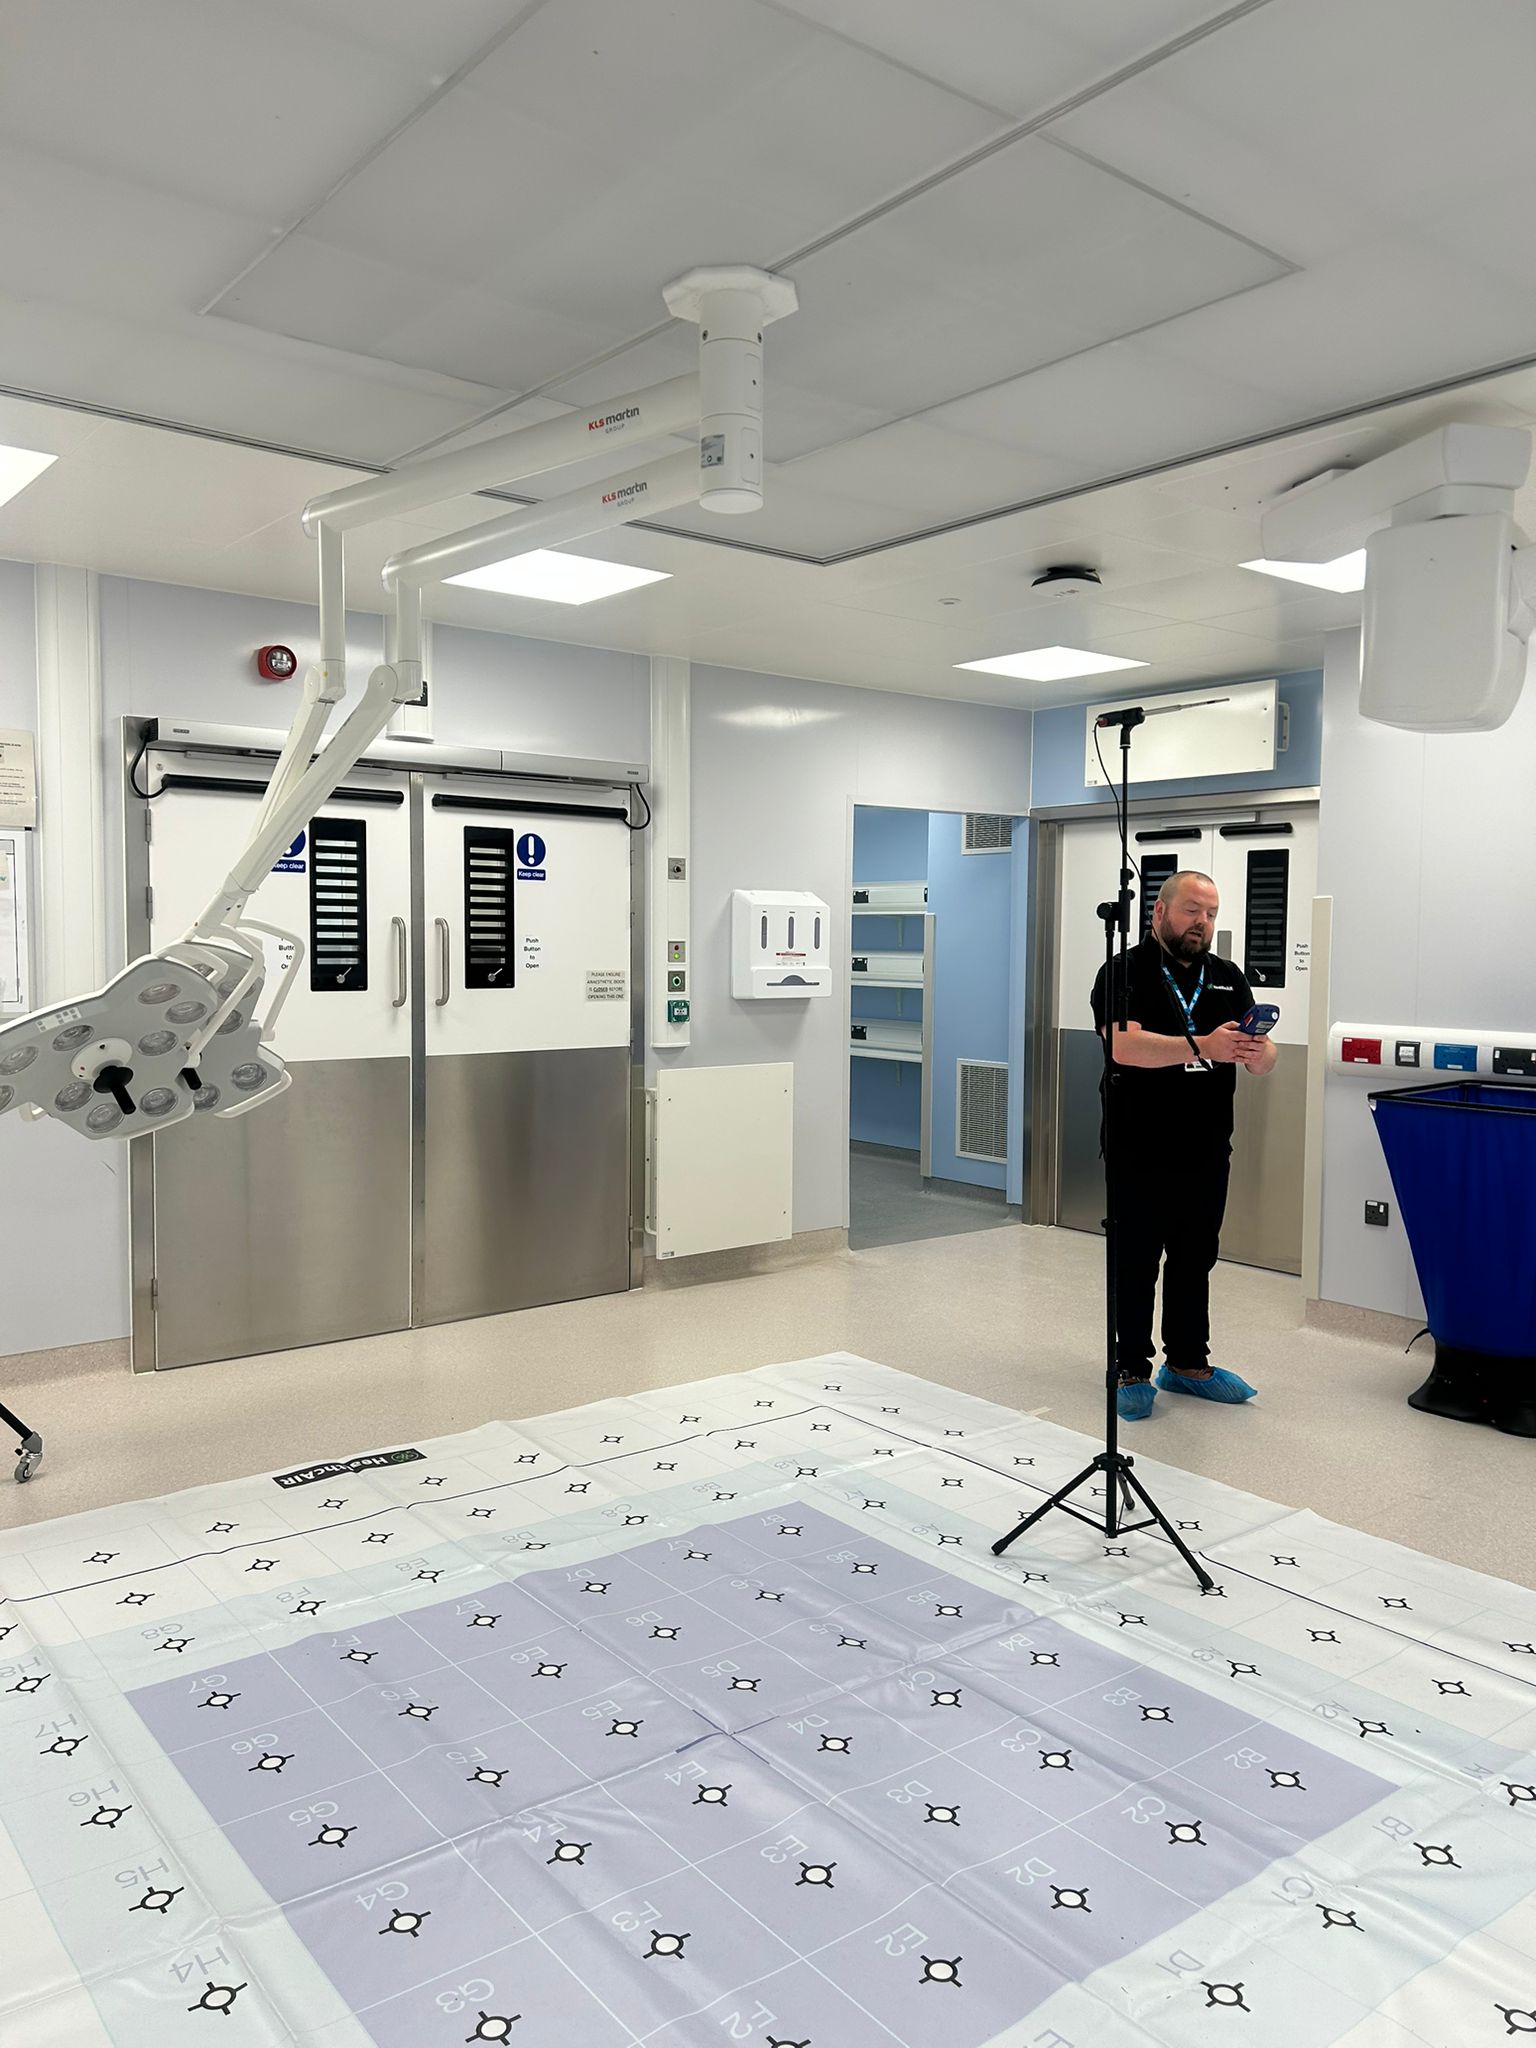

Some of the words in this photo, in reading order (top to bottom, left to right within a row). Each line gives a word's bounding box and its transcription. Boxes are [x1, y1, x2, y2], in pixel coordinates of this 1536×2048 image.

[605, 407, 640, 425] martin
[617, 482, 648, 499] martin
[760, 1514, 787, 1527] B7
[502, 1531, 536, 1544] D8
[395, 1557, 429, 1572] E8
[826, 1550, 859, 1564] B6
[566, 1568, 596, 1583] D7
[276, 1586, 312, 1603] F8
[907, 1589, 941, 1606] B5
[455, 1599, 486, 1616] E7
[626, 1610, 664, 1627] D6
[809, 1622, 844, 1635] C5
[141, 1623, 183, 1640] G8
[331, 1634, 362, 1648] F7
[998, 1632, 1034, 1651] B4
[510, 1645, 550, 1664] E6
[701, 1660, 741, 1678] D5
[189, 1674, 228, 1694] G7
[898, 1670, 935, 1691] C4
[381, 1687, 420, 1701] F6
[1103, 1686, 1142, 1706] B3
[581, 1700, 623, 1721] E5
[35, 1713, 78, 1739] H7
[787, 1713, 829, 1735] D4
[231, 1733, 279, 1754] G6
[1000, 1728, 1042, 1752] C3
[446, 1747, 488, 1765] F5
[1224, 1747, 1267, 1770] B2
[664, 1760, 708, 1786] E4
[68, 1779, 120, 1807] H6
[886, 1780, 933, 1804] D3
[288, 1800, 339, 1827] G5
[1120, 1796, 1166, 1824] C2
[1372, 1816, 1415, 1841] B1
[760, 1834, 809, 1864] E3
[114, 1857, 170, 1889] H5
[1004, 1857, 1057, 1885] D2
[355, 1881, 409, 1912] G4
[1271, 1876, 1314, 1906] C1
[612, 1901, 663, 1932] F3
[874, 1922, 929, 1957] E2
[168, 1946, 231, 1984] H4
[1155, 1949, 1205, 1979] D1
[435, 1978, 495, 2014] G3
[719, 2000, 778, 2039] F2
